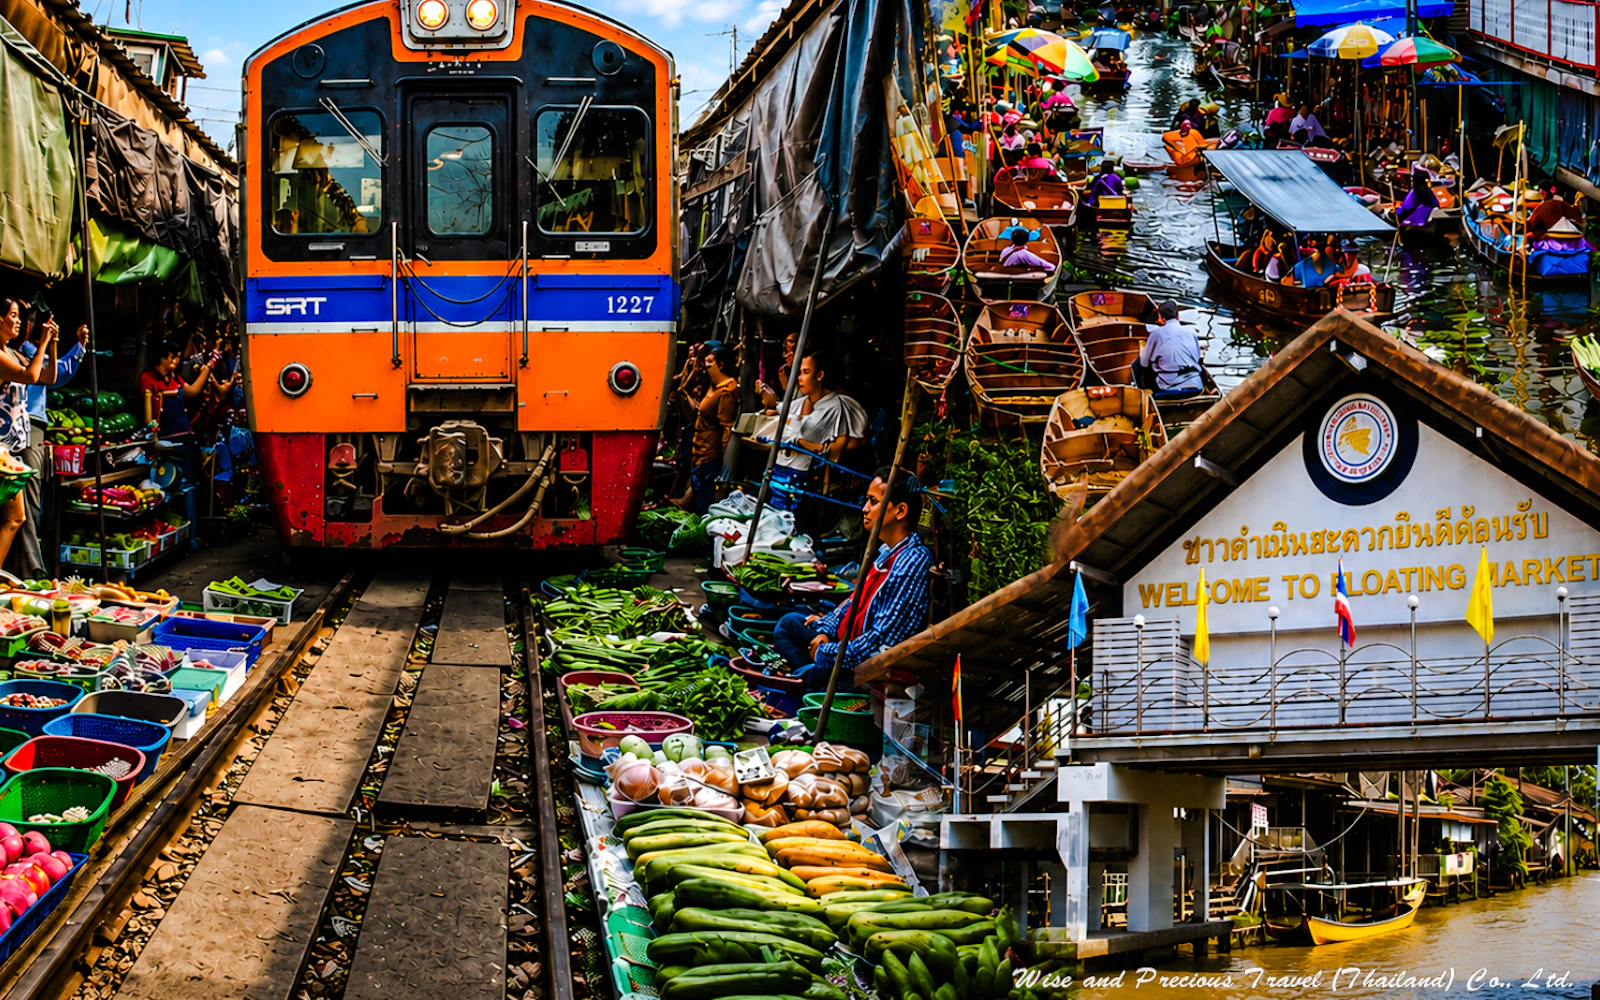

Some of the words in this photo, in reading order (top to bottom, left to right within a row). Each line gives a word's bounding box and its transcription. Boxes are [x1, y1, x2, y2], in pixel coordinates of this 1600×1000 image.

[265, 296, 327, 316] SRT
[607, 295, 655, 314] 1227
[1282, 573, 1320, 600] TO
